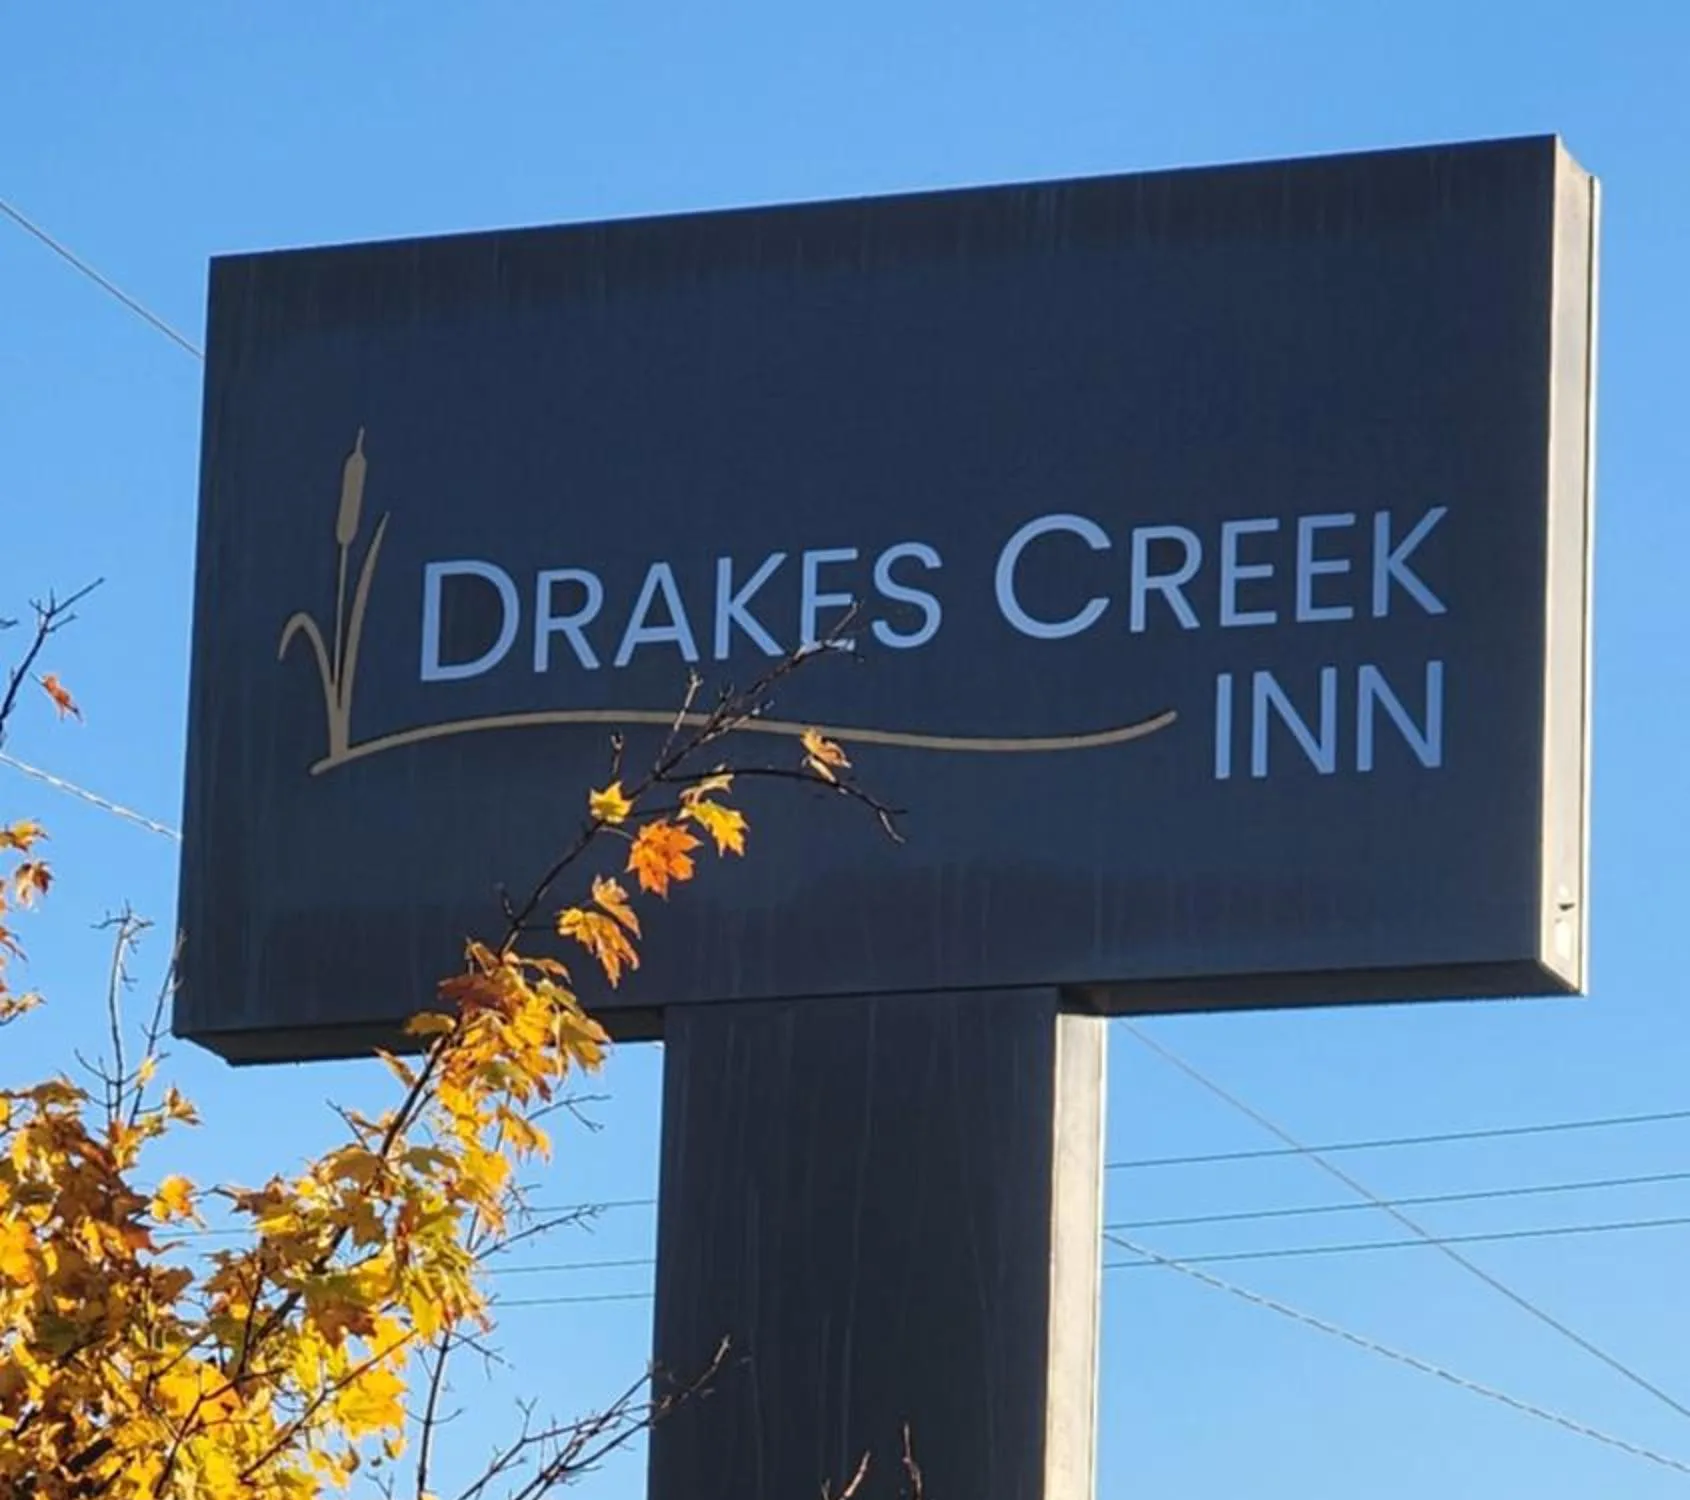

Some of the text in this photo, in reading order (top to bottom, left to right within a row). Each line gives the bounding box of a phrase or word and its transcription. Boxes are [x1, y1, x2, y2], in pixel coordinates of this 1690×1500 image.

[420, 506, 1448, 681] DRAKES CREEK
[1216, 660, 1443, 779] INN
